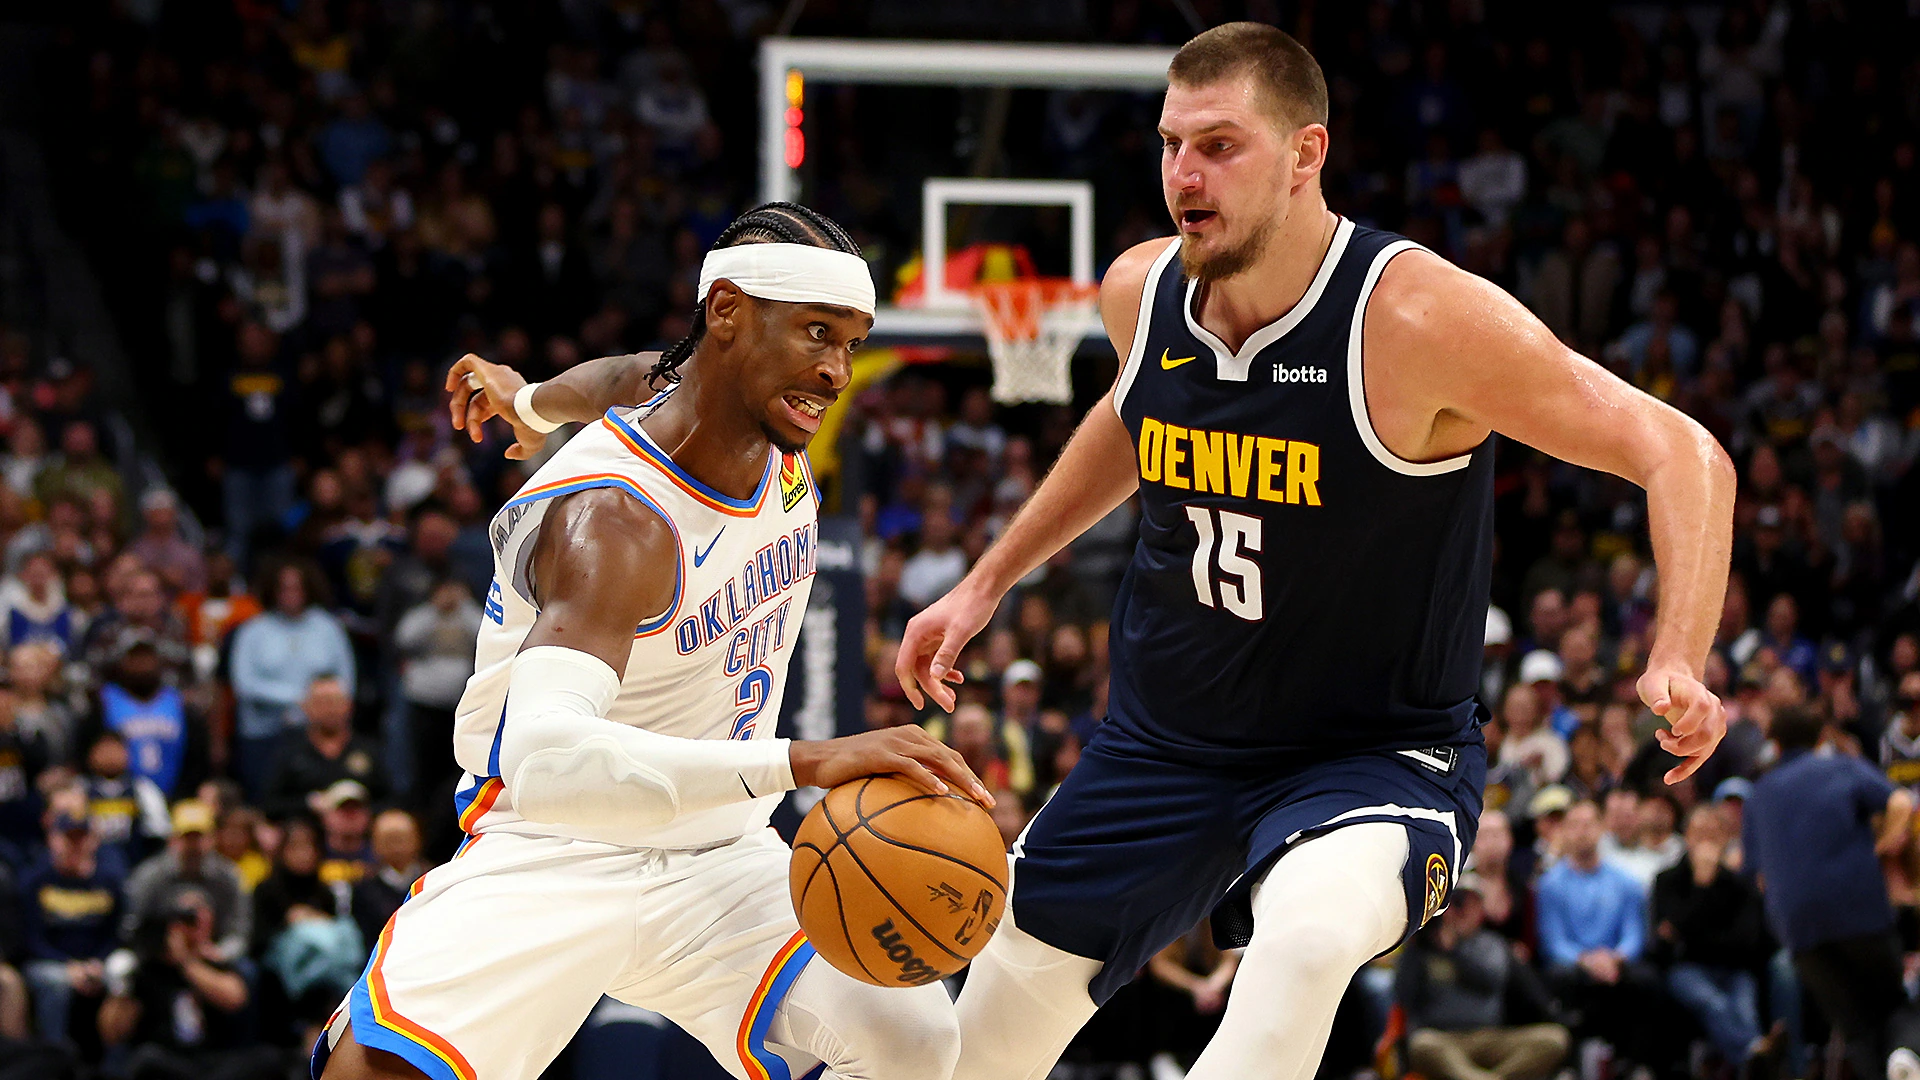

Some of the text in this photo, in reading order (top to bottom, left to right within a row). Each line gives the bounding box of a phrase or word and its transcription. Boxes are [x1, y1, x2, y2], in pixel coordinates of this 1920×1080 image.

[1272, 363, 1327, 383] ibotta
[1138, 415, 1323, 507] DENVER
[485, 575, 504, 626] ER
[1183, 504, 1264, 622] 15
[723, 596, 792, 677] CITY
[727, 664, 774, 741] 2
